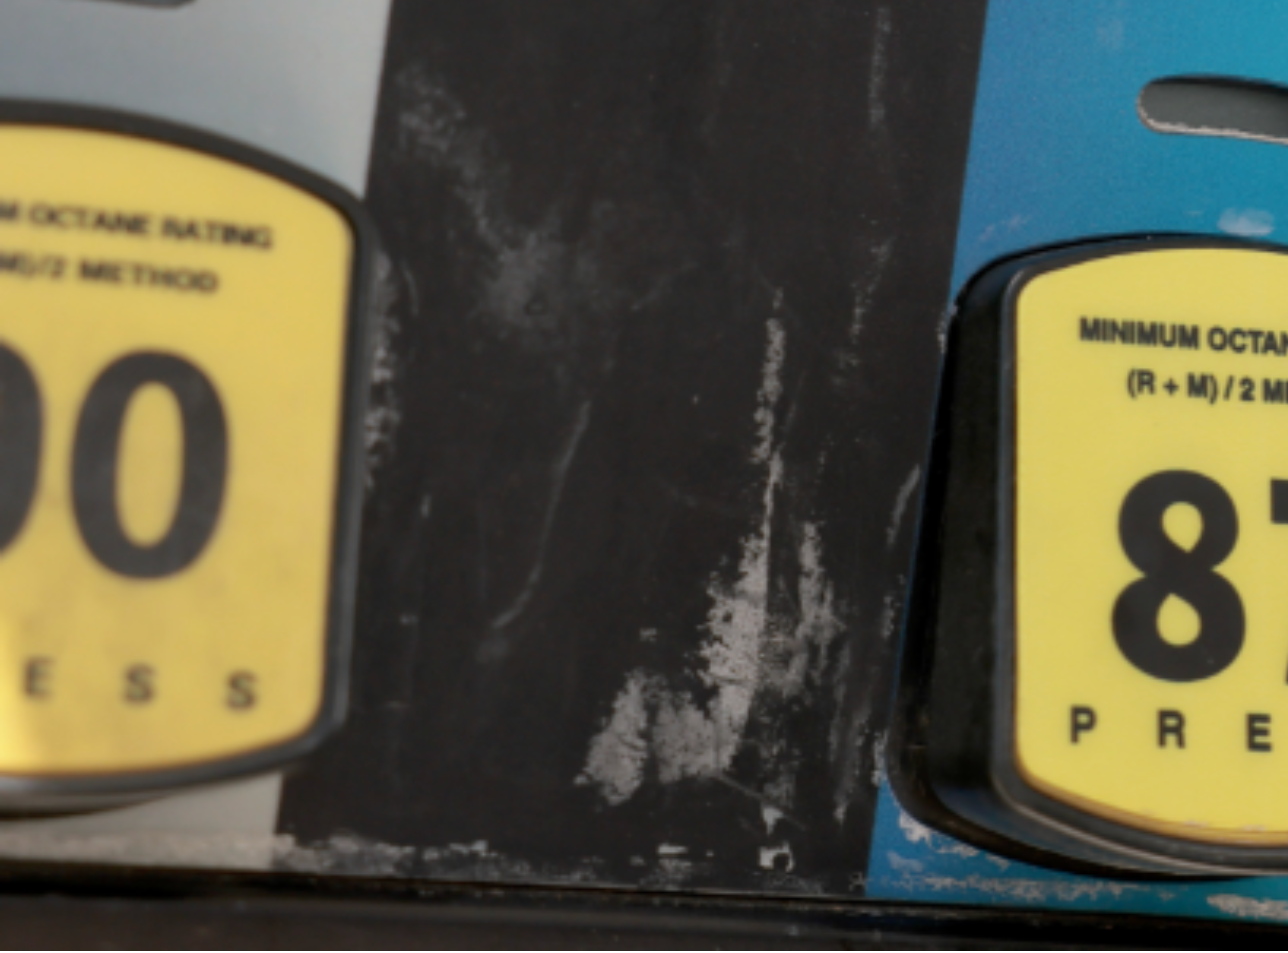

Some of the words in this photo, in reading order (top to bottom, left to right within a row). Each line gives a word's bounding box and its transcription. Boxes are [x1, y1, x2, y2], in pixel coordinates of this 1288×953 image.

[27, 204, 151, 236] OCTANE
[160, 217, 272, 250] RATING
[78, 259, 218, 294] METHOD
[1079, 317, 1200, 349] MINIMUM
[1127, 370, 1157, 397] (R
[1163, 378, 1179, 395] +
[0, 339, 229, 581] 0
